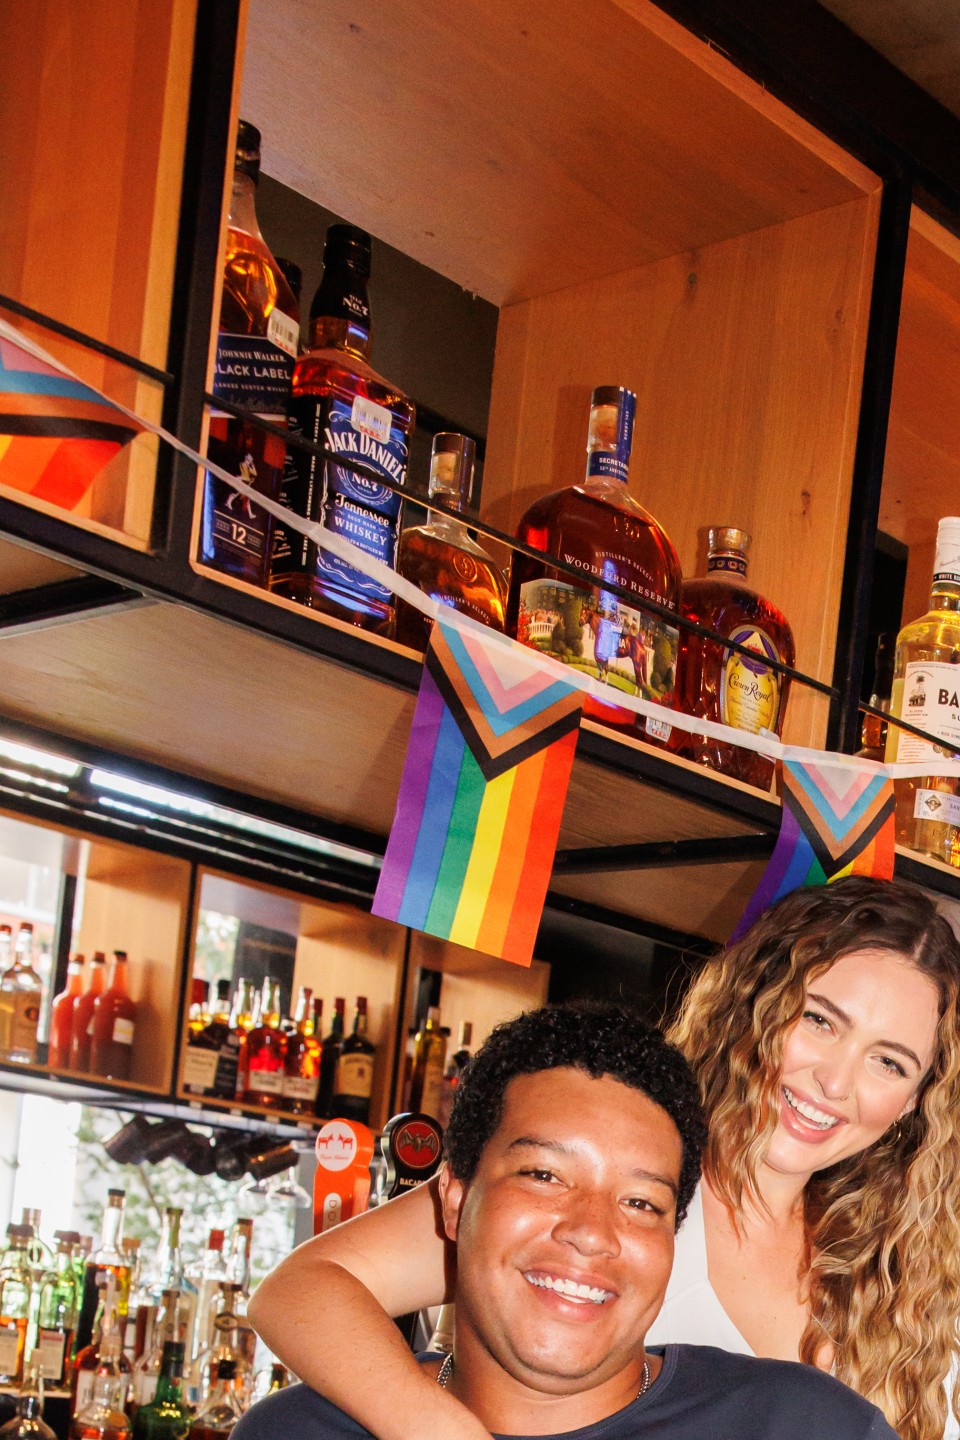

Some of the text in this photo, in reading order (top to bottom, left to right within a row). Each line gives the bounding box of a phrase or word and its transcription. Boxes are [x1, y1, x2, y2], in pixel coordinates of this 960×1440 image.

[218, 348, 253, 360] JOHNNIE
[253, 367, 291, 380] LABEL
[324, 427, 358, 453] JACK
[334, 492, 390, 528] Tennessee
[231, 523, 247, 545] 12
[334, 516, 388, 546] WHISKEY
[728, 673, 774, 702] Crown Royal
